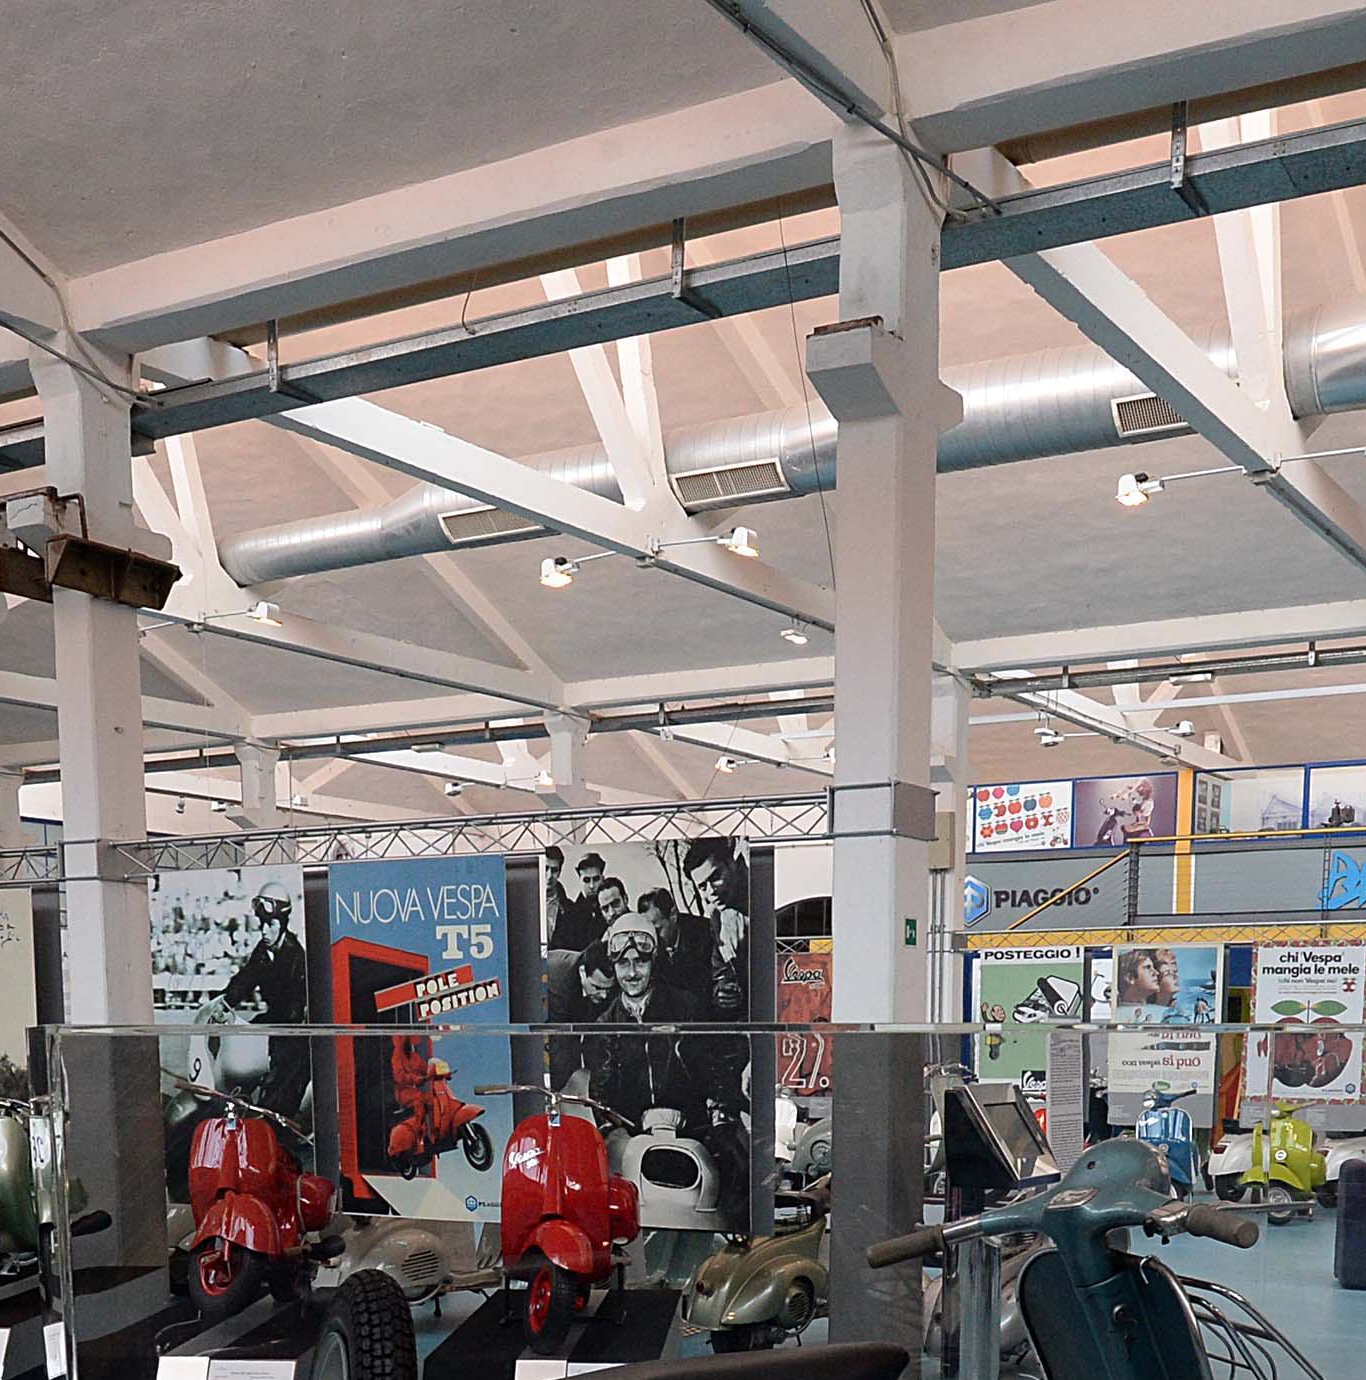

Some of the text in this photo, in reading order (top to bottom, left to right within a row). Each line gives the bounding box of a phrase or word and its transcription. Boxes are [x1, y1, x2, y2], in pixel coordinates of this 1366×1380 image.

[335, 884, 500, 925] NUOVA VESPA
[993, 887, 1092, 909] PIAGGIO
[435, 924, 494, 960] T5
[984, 949, 1072, 961] POSTEGGIO
[1279, 952, 1299, 963] chi
[781, 956, 826, 985] Vespa
[1262, 963, 1360, 978] mangia le mele
[415, 972, 460, 999] POLE
[419, 982, 500, 1018] POSITION
[188, 1057, 202, 1082] 9
[1162, 1055, 1174, 1067] si
